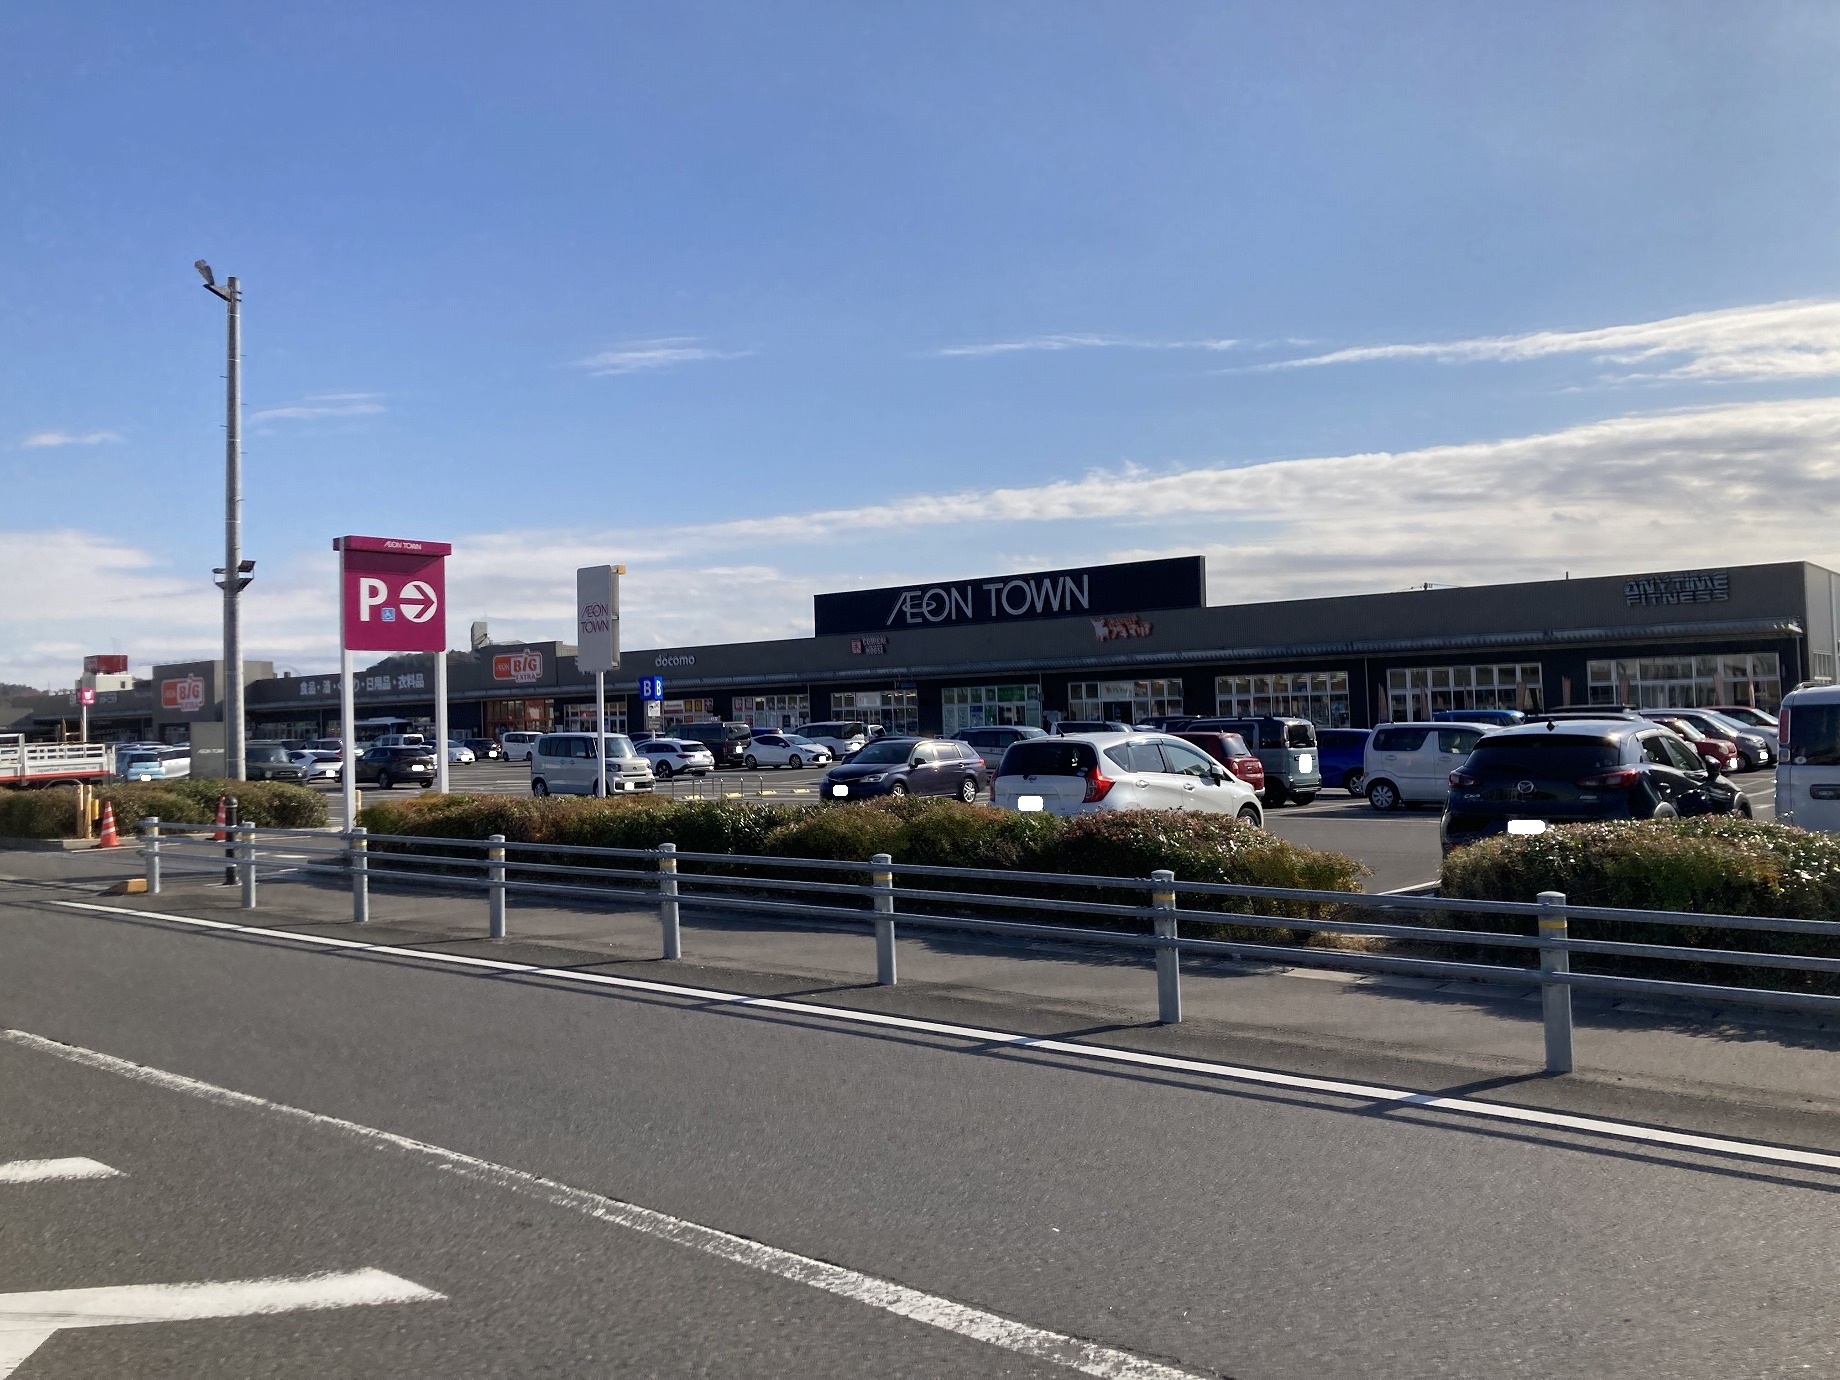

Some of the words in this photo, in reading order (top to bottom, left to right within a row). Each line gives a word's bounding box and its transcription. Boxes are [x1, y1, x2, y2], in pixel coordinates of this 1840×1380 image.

[1623, 574, 1728, 595] ANYTIME
[360, 577, 388, 622] P
[982, 574, 1090, 617] TOWN
[1625, 590, 1728, 606] FITNESS
[580, 619, 609, 634] TOWN
[513, 656, 537, 672] BIG
[655, 654, 695, 667] docomo
[643, 680, 652, 697] B
[656, 680, 662, 697] B
